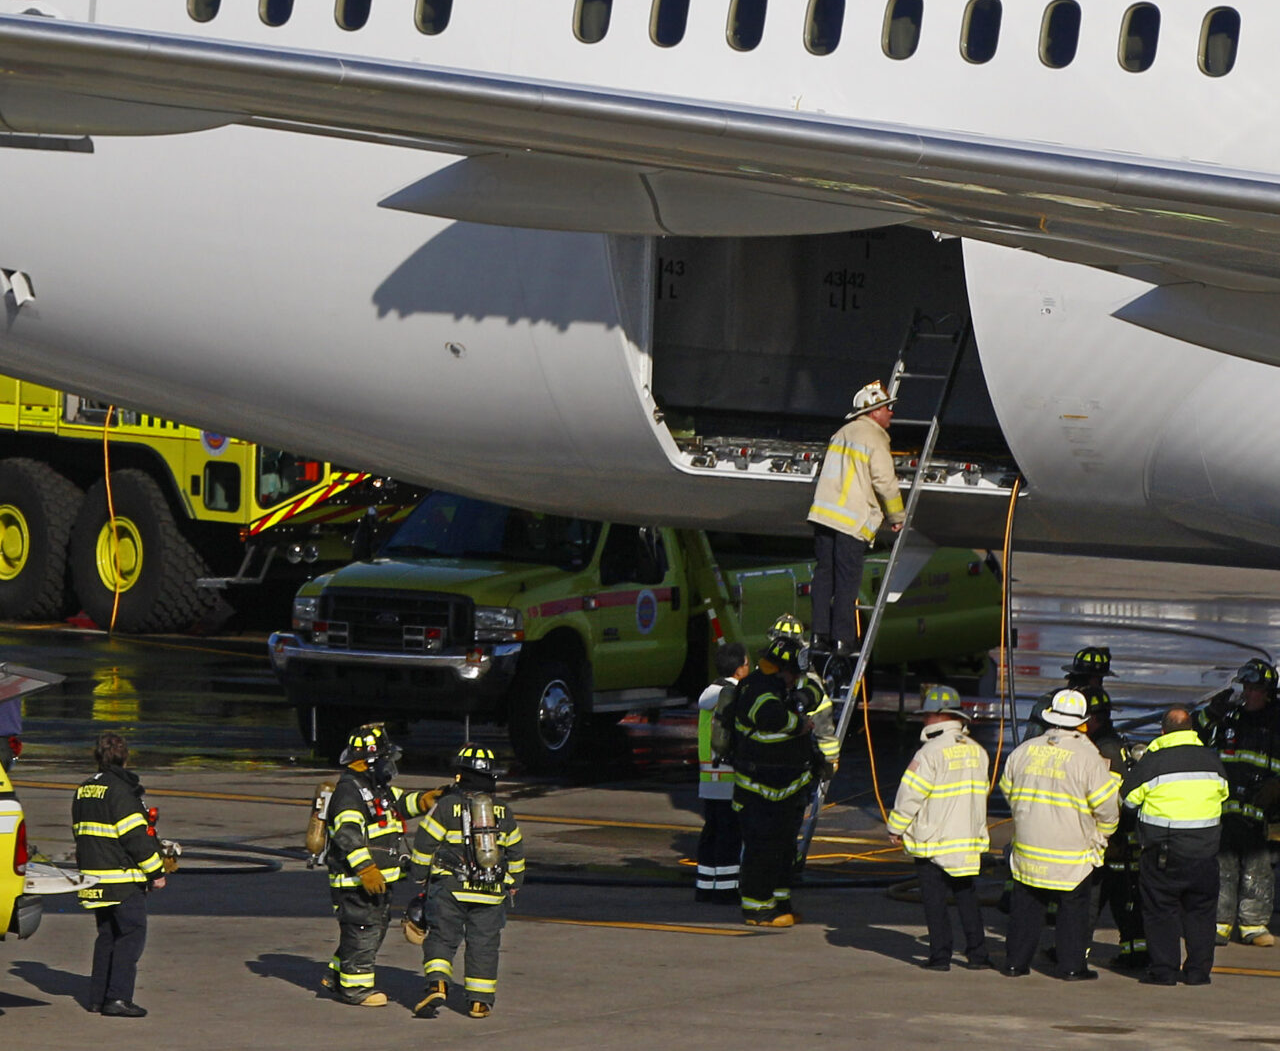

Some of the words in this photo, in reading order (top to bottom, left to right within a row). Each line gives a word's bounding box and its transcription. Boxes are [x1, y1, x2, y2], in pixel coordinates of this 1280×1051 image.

[664, 261, 685, 276] 43
[823, 271, 843, 287] 43
[847, 272, 865, 288] 42
[670, 284, 677, 299] L
[77, 785, 108, 799] MSPORT
